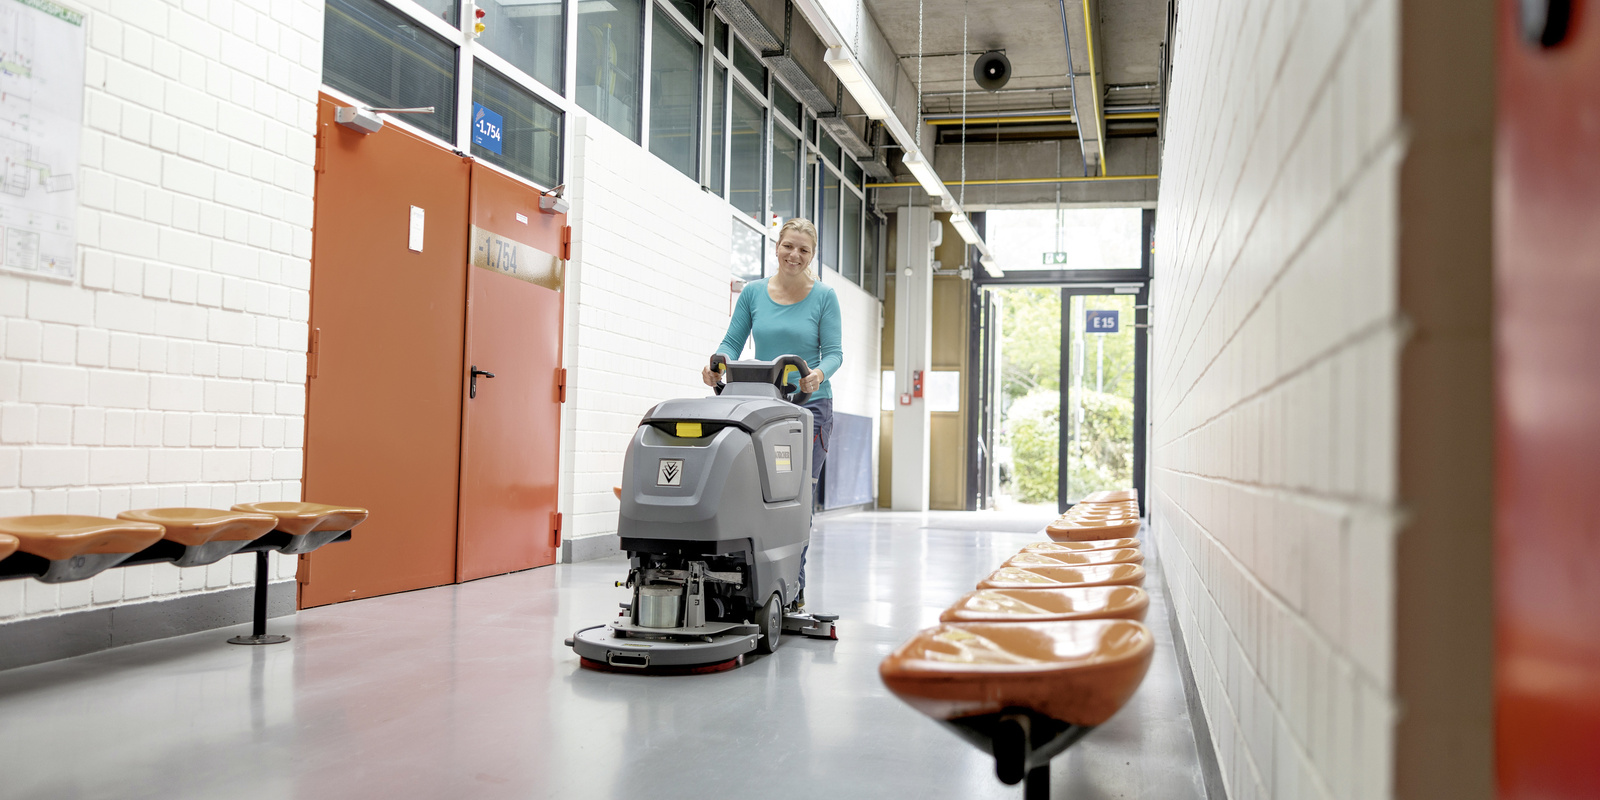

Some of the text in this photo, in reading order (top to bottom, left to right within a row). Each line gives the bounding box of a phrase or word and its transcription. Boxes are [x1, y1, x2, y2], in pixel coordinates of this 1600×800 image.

[476, 119, 501, 141] -1.754
[479, 236, 518, 274] -1.754
[1093, 316, 1115, 329] E 15
